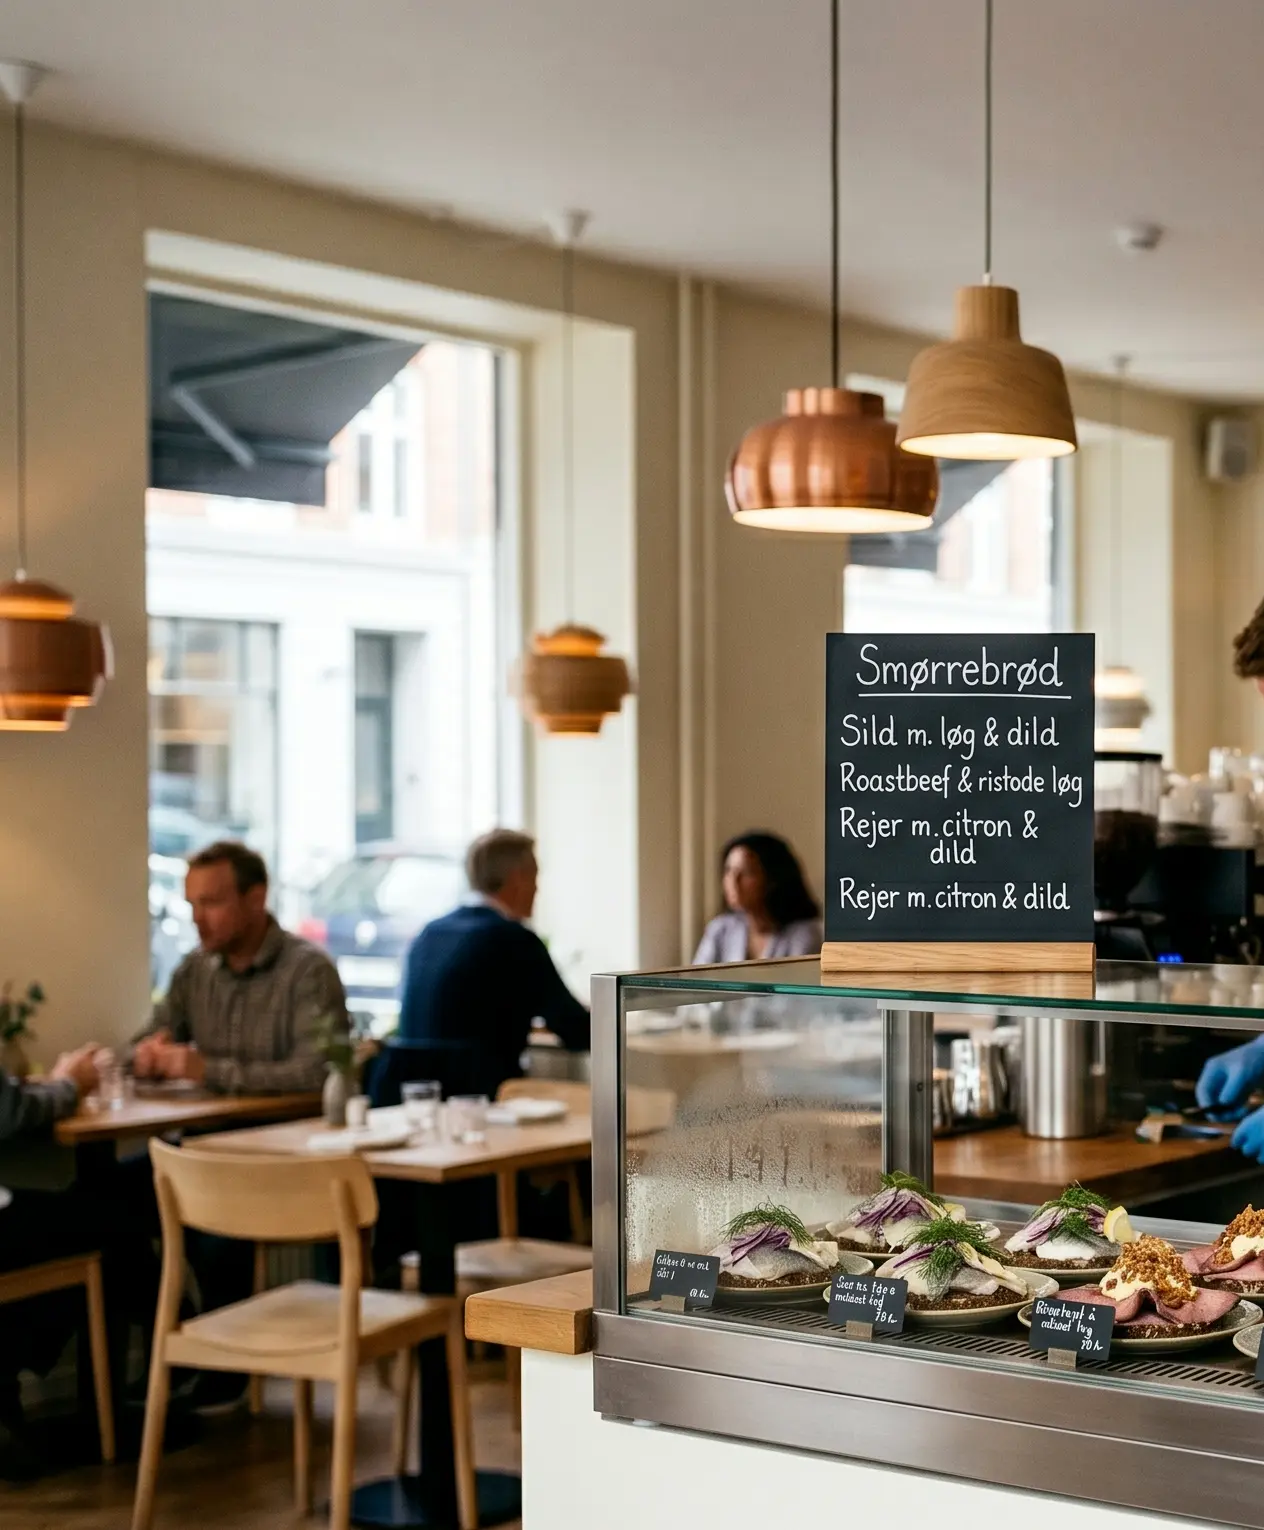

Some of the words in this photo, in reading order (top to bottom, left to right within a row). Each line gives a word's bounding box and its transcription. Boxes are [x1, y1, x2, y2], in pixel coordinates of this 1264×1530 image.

[855, 643, 1064, 692] Smørrebrød
[840, 713, 898, 747] Sild
[907, 726, 933, 747] m.
[941, 716, 976, 760] løg
[983, 716, 999, 747] &
[1007, 716, 1060, 747] dild
[840, 762, 952, 798] Roastbeef
[957, 765, 972, 793] &
[978, 766, 1045, 793] ristode
[1052, 766, 1083, 808] løg
[840, 807, 903, 848] Rejer
[1022, 810, 1039, 839] &
[930, 839, 977, 865] dild
[840, 877, 900, 921] Rejer
[1002, 882, 1017, 910] &
[1023, 883, 1071, 910] dild
